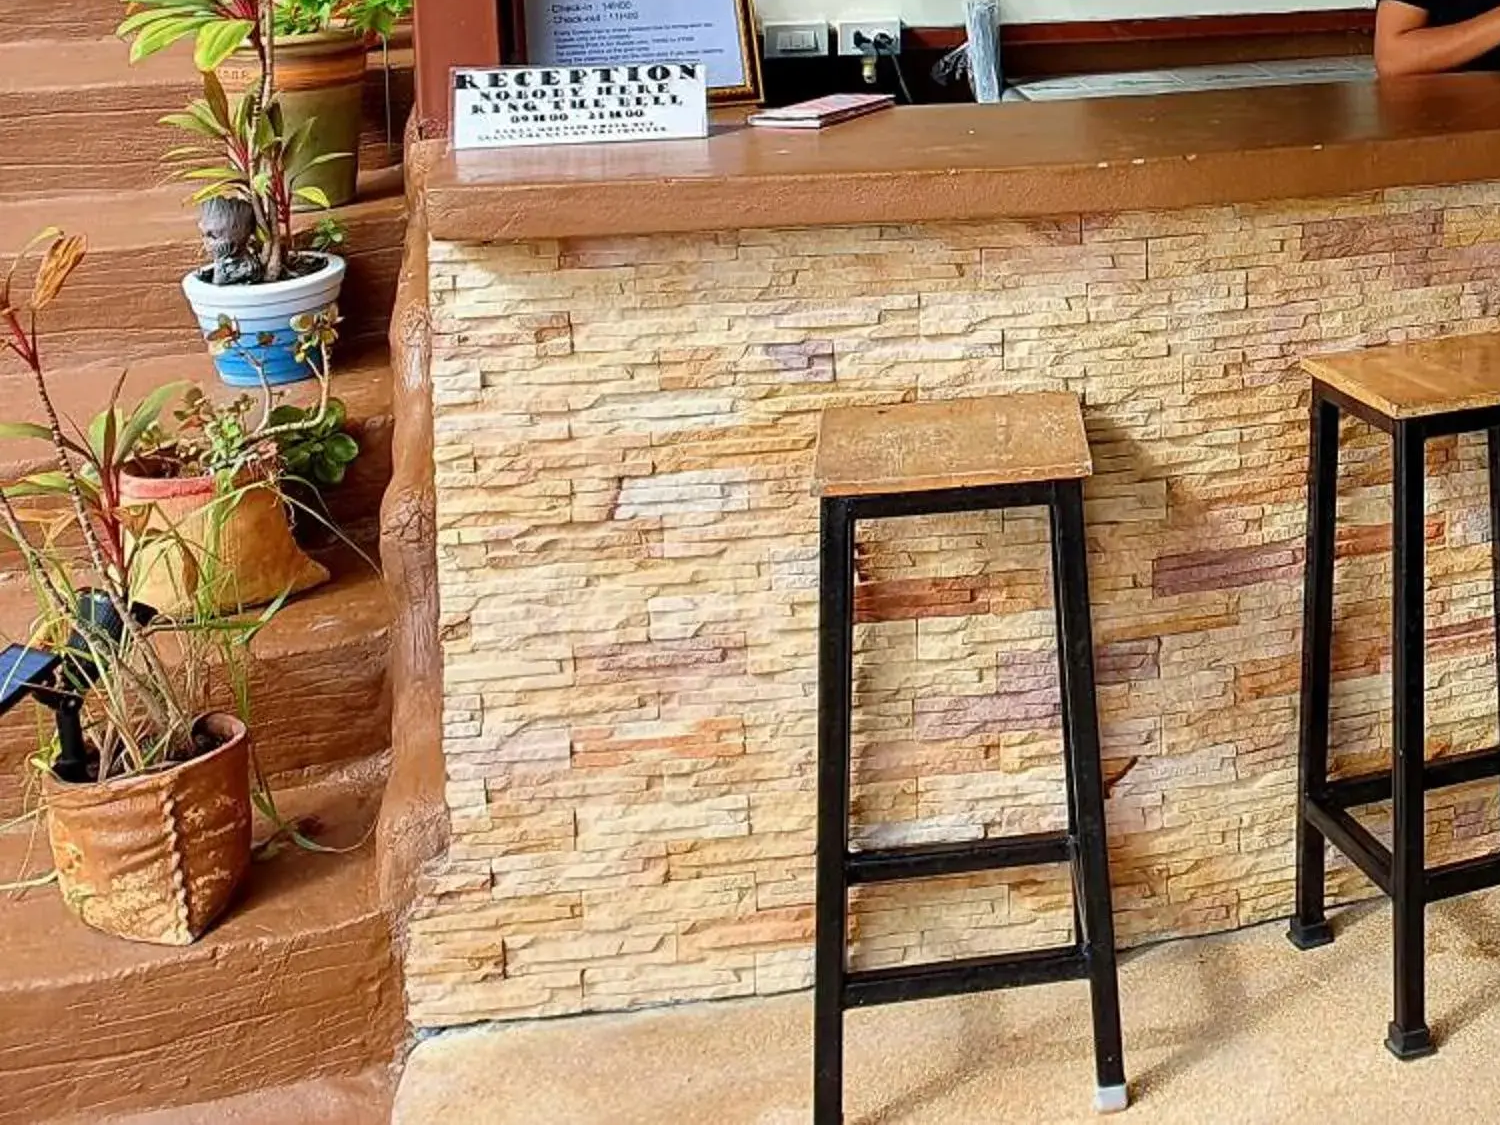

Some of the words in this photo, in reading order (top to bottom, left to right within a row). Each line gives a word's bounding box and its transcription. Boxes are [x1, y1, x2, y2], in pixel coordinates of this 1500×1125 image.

[453, 64, 698, 90] RECEPTION
[480, 86, 583, 102] NOBODY
[597, 82, 669, 96] HERE
[471, 101, 537, 115] RING
[554, 98, 605, 111] THE
[619, 94, 684, 108] BELL
[510, 112, 569, 124] 09H00
[588, 109, 645, 121] 21H00
